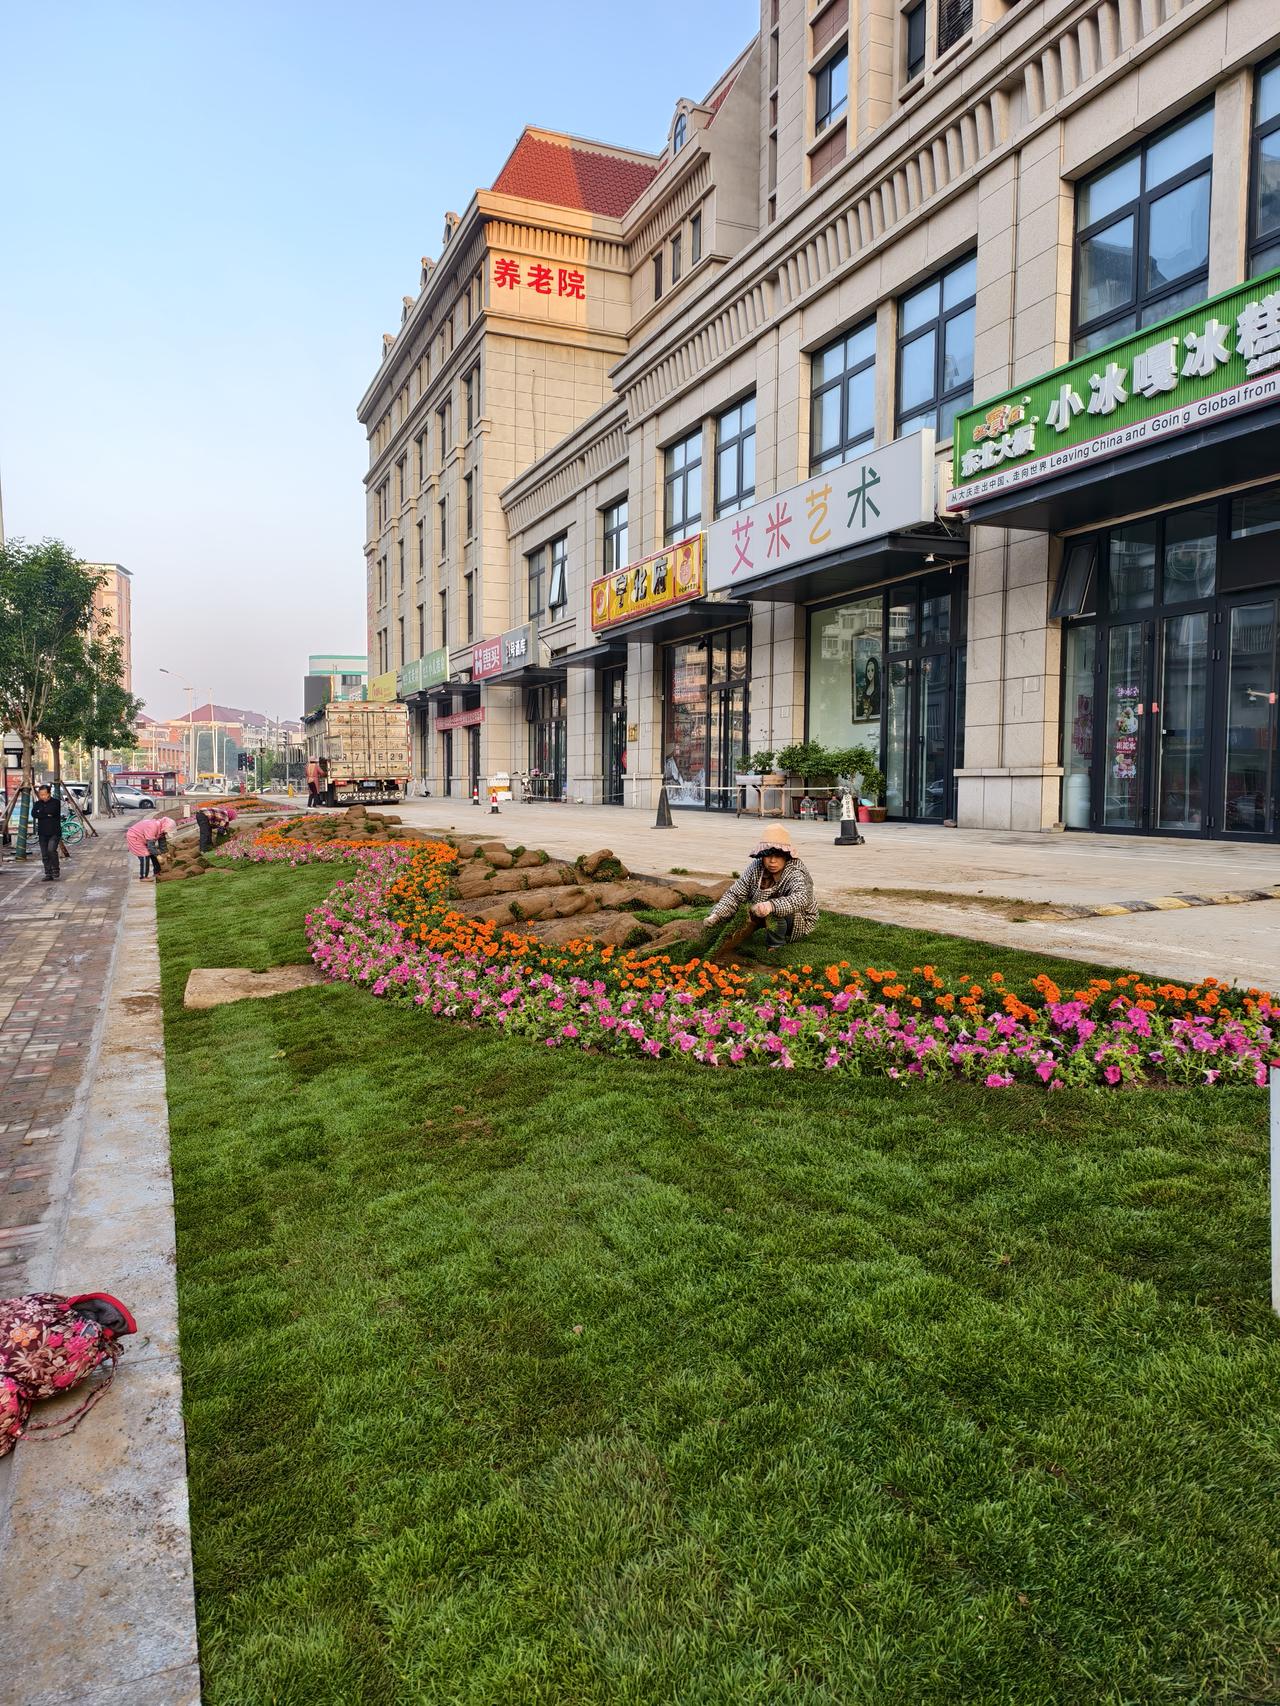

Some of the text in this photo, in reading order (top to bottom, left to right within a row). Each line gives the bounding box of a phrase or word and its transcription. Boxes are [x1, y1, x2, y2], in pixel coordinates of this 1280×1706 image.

[494, 258, 586, 300] 养老院
[1050, 447, 1090, 469] Leaving
[1092, 434, 1123, 454] China
[1125, 424, 1147, 442] and
[1198, 391, 1241, 416] Global
[1243, 380, 1276, 402] from
[731, 465, 881, 576] 艾米艺术
[615, 556, 668, 609] 宁化府
[483, 645, 500, 671] 惠买
